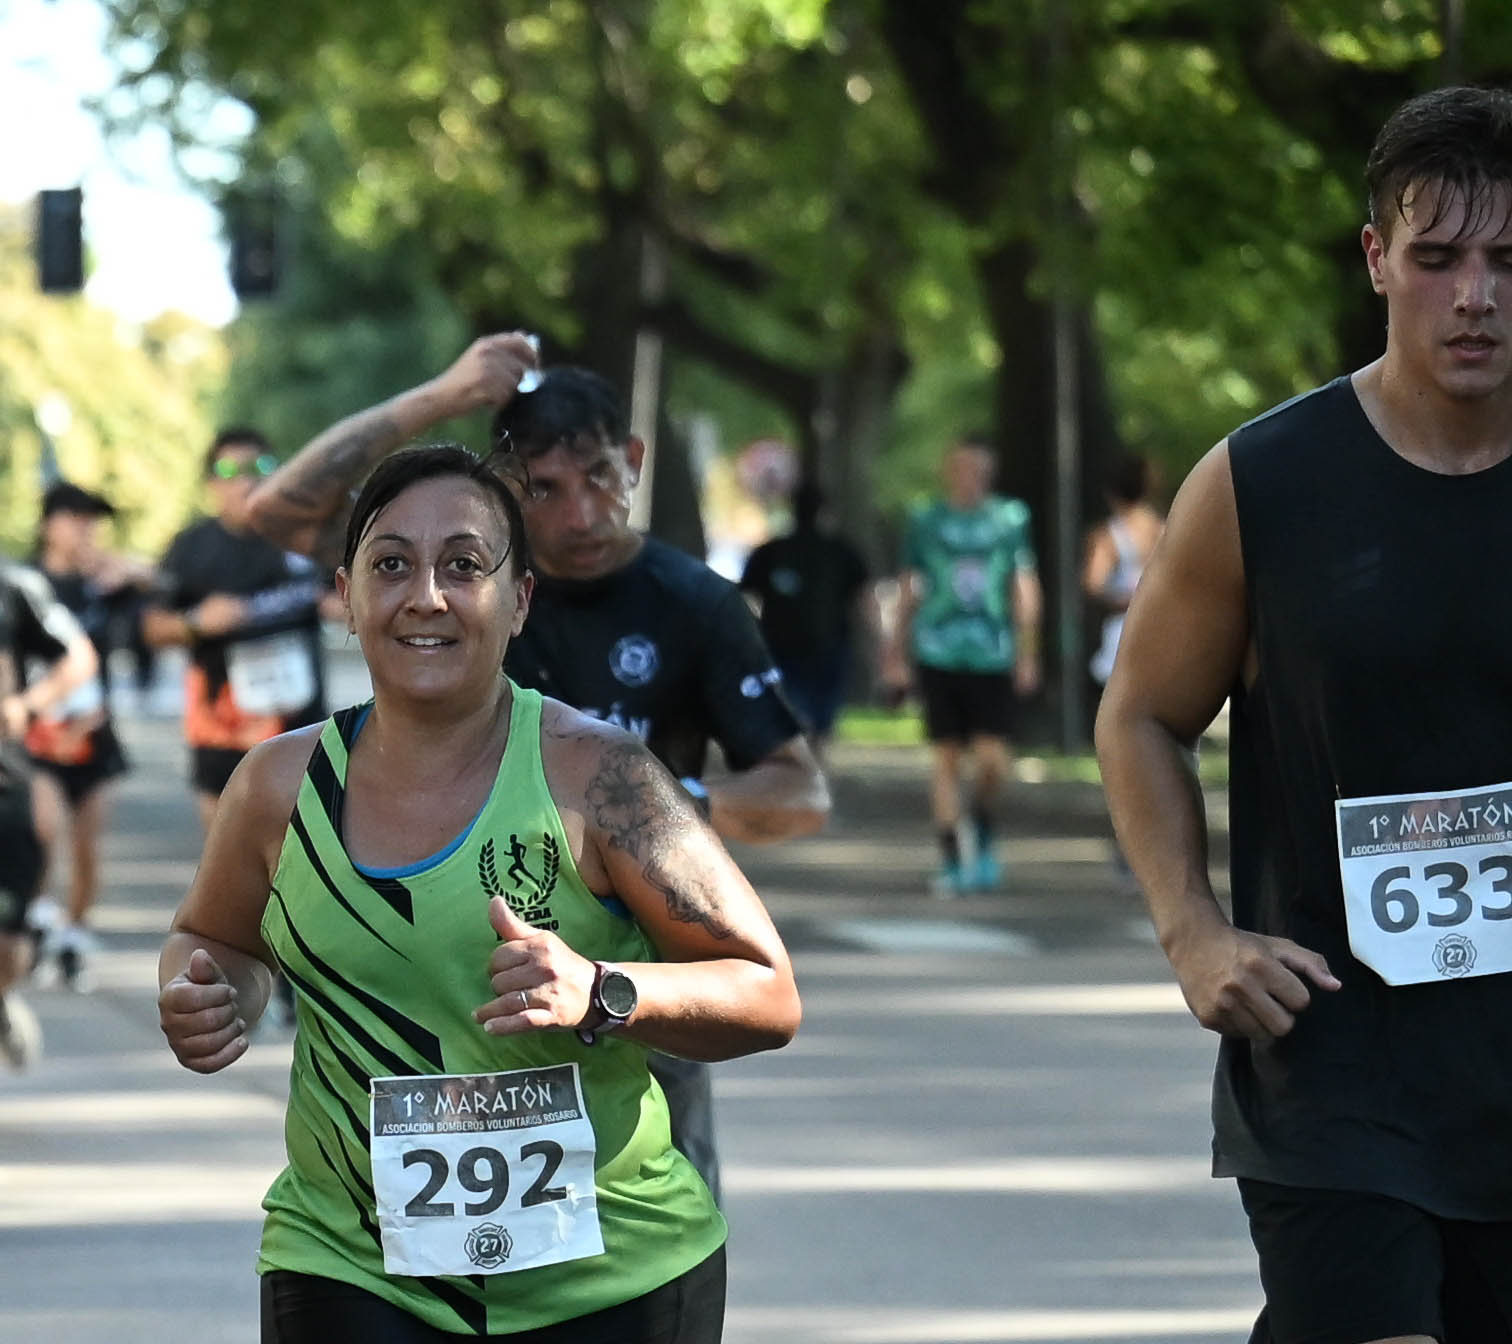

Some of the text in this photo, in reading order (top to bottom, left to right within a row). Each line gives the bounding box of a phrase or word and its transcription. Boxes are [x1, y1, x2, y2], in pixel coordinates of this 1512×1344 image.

[1370, 855, 1512, 933] 633
[1446, 948, 1464, 964] 27
[433, 1077, 553, 1116] MARATÓN
[486, 1113, 542, 1130] VOLUNTARIOS
[402, 1140, 567, 1217] 292
[479, 1237, 499, 1251] 27
